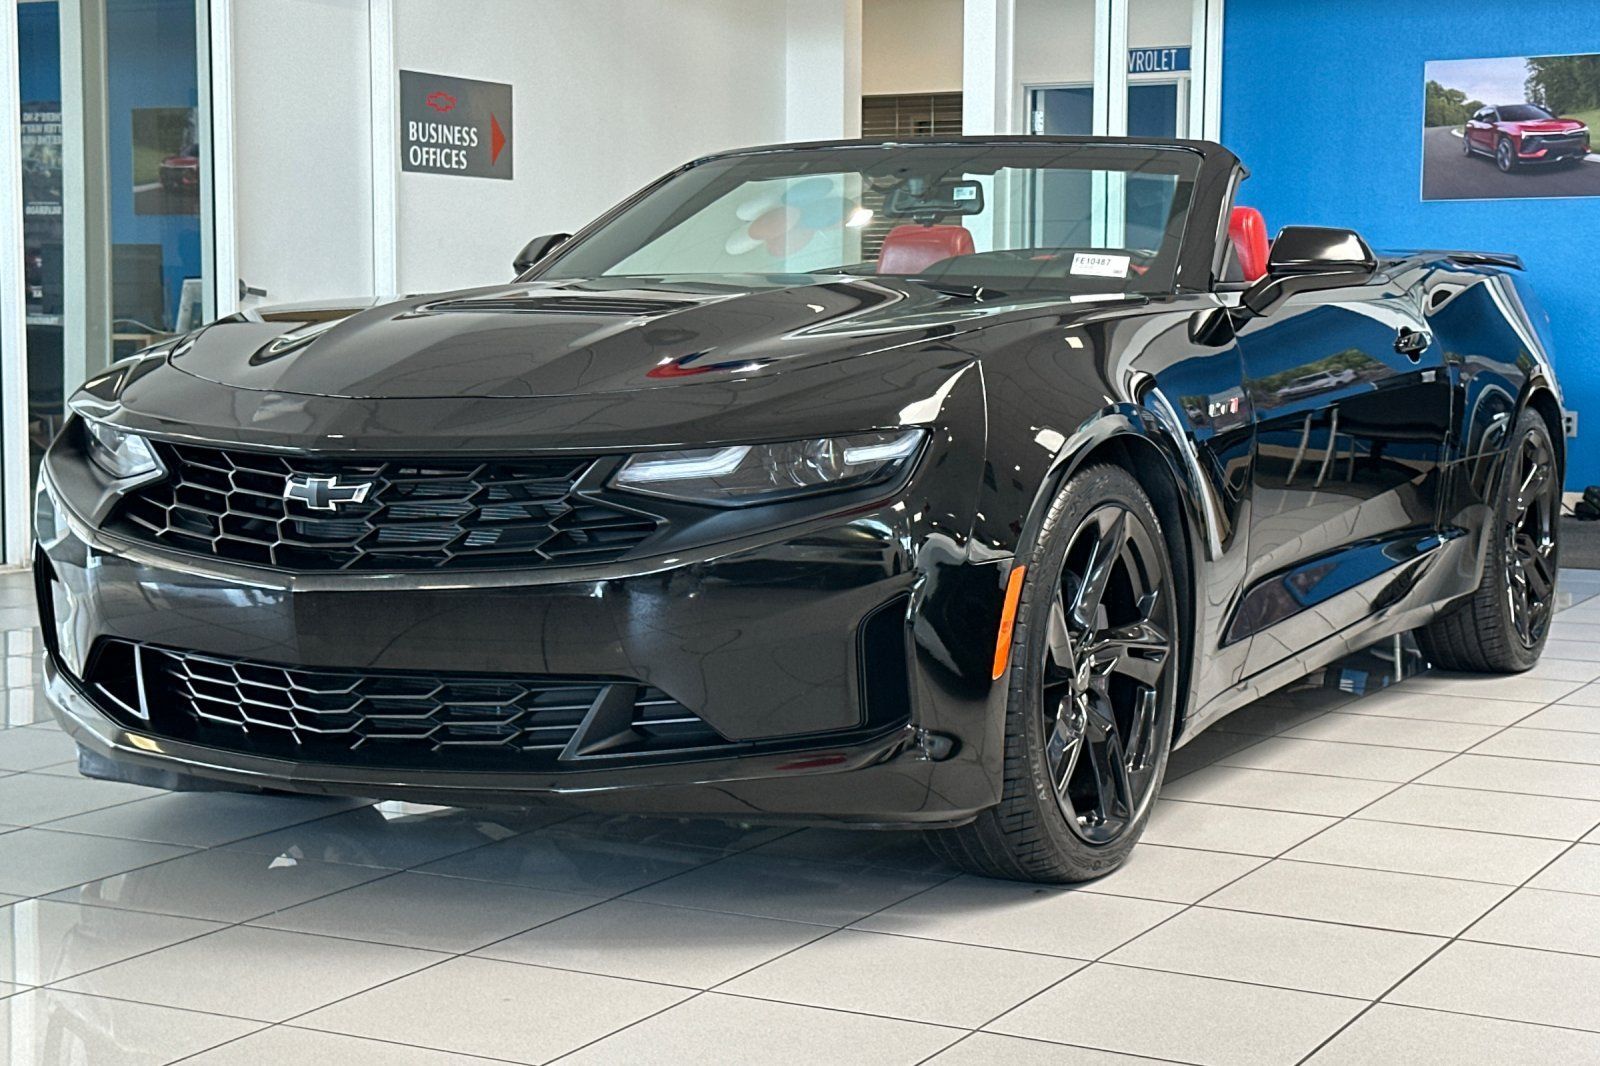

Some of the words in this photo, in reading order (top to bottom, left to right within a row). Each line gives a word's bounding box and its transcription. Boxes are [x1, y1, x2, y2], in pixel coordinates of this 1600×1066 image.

[1128, 49, 1177, 72] VROLET
[408, 120, 478, 147] BUSINESS
[409, 145, 468, 169] OFFICES
